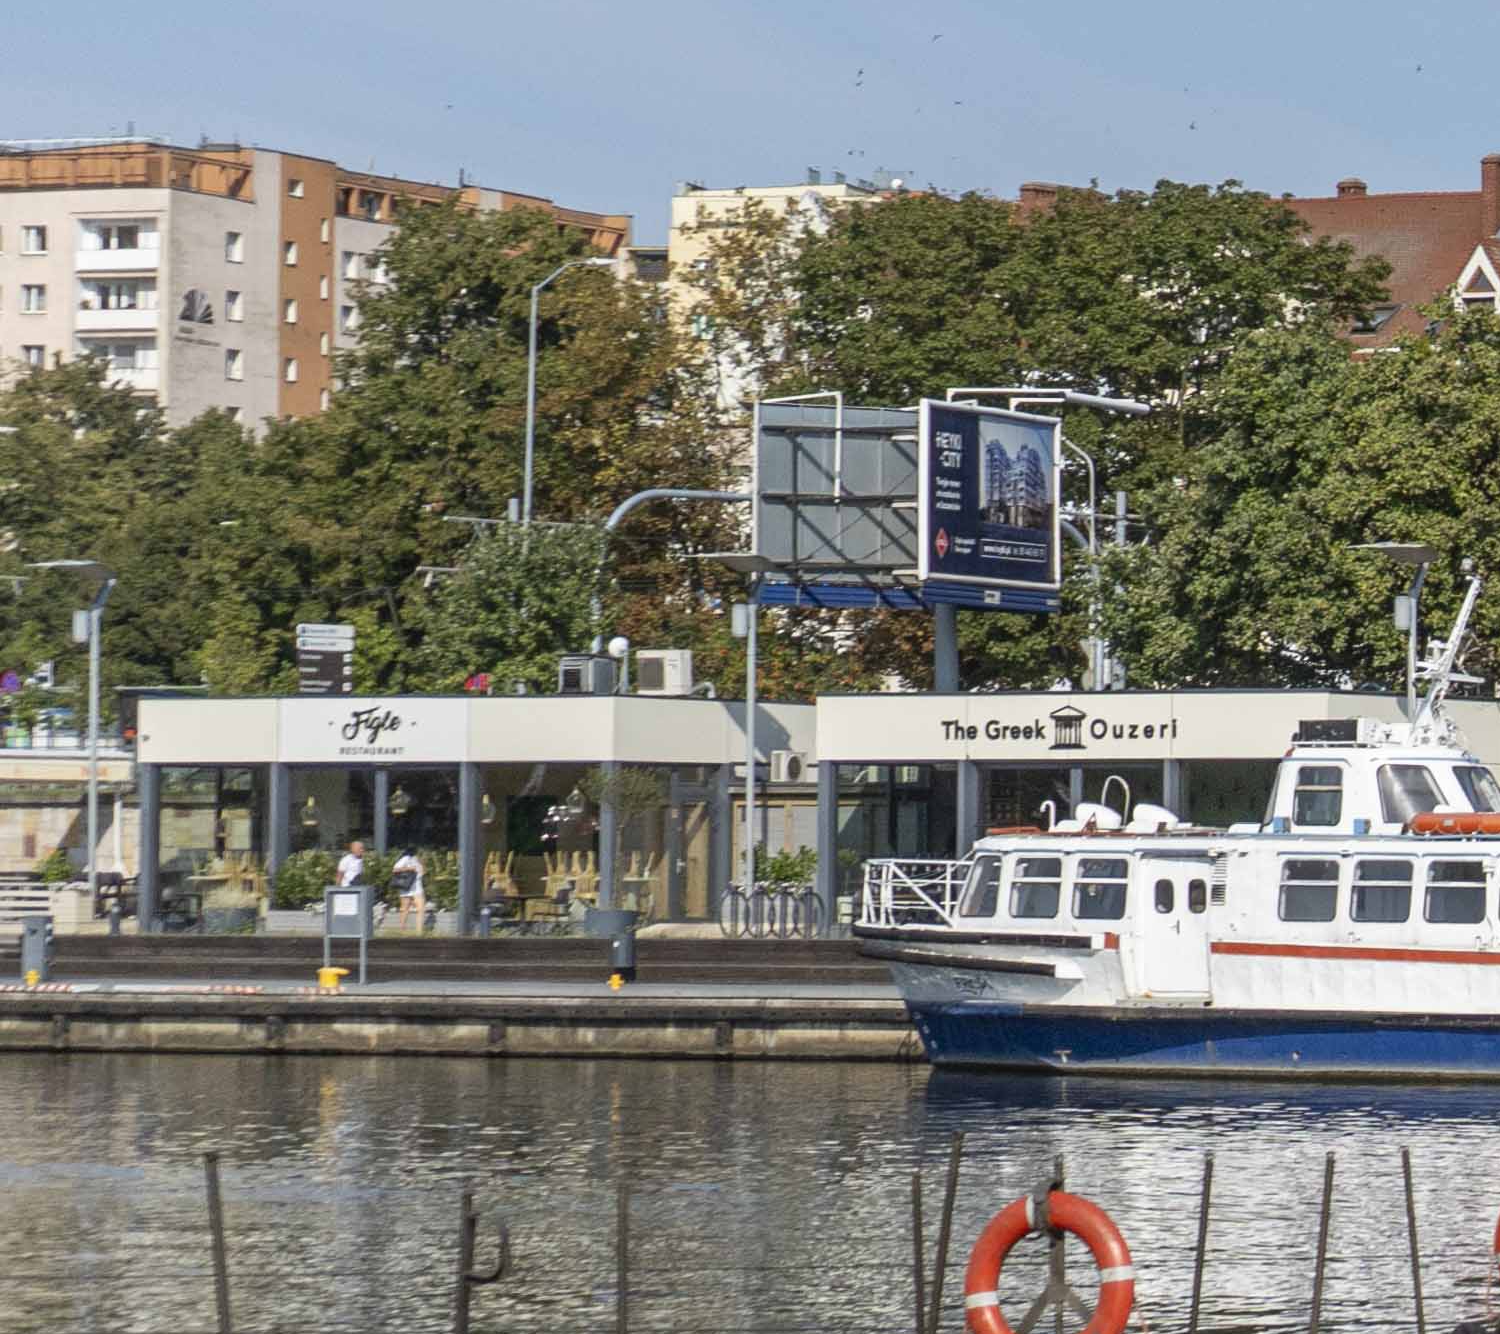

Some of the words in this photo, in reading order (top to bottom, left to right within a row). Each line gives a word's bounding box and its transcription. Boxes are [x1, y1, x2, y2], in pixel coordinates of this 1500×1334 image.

[342, 705, 402, 744] Figle
[941, 719, 979, 740] The
[985, 718, 1046, 741] Greek
[1090, 718, 1178, 741] Ouzeri
[339, 746, 404, 756] RESTAURANT
